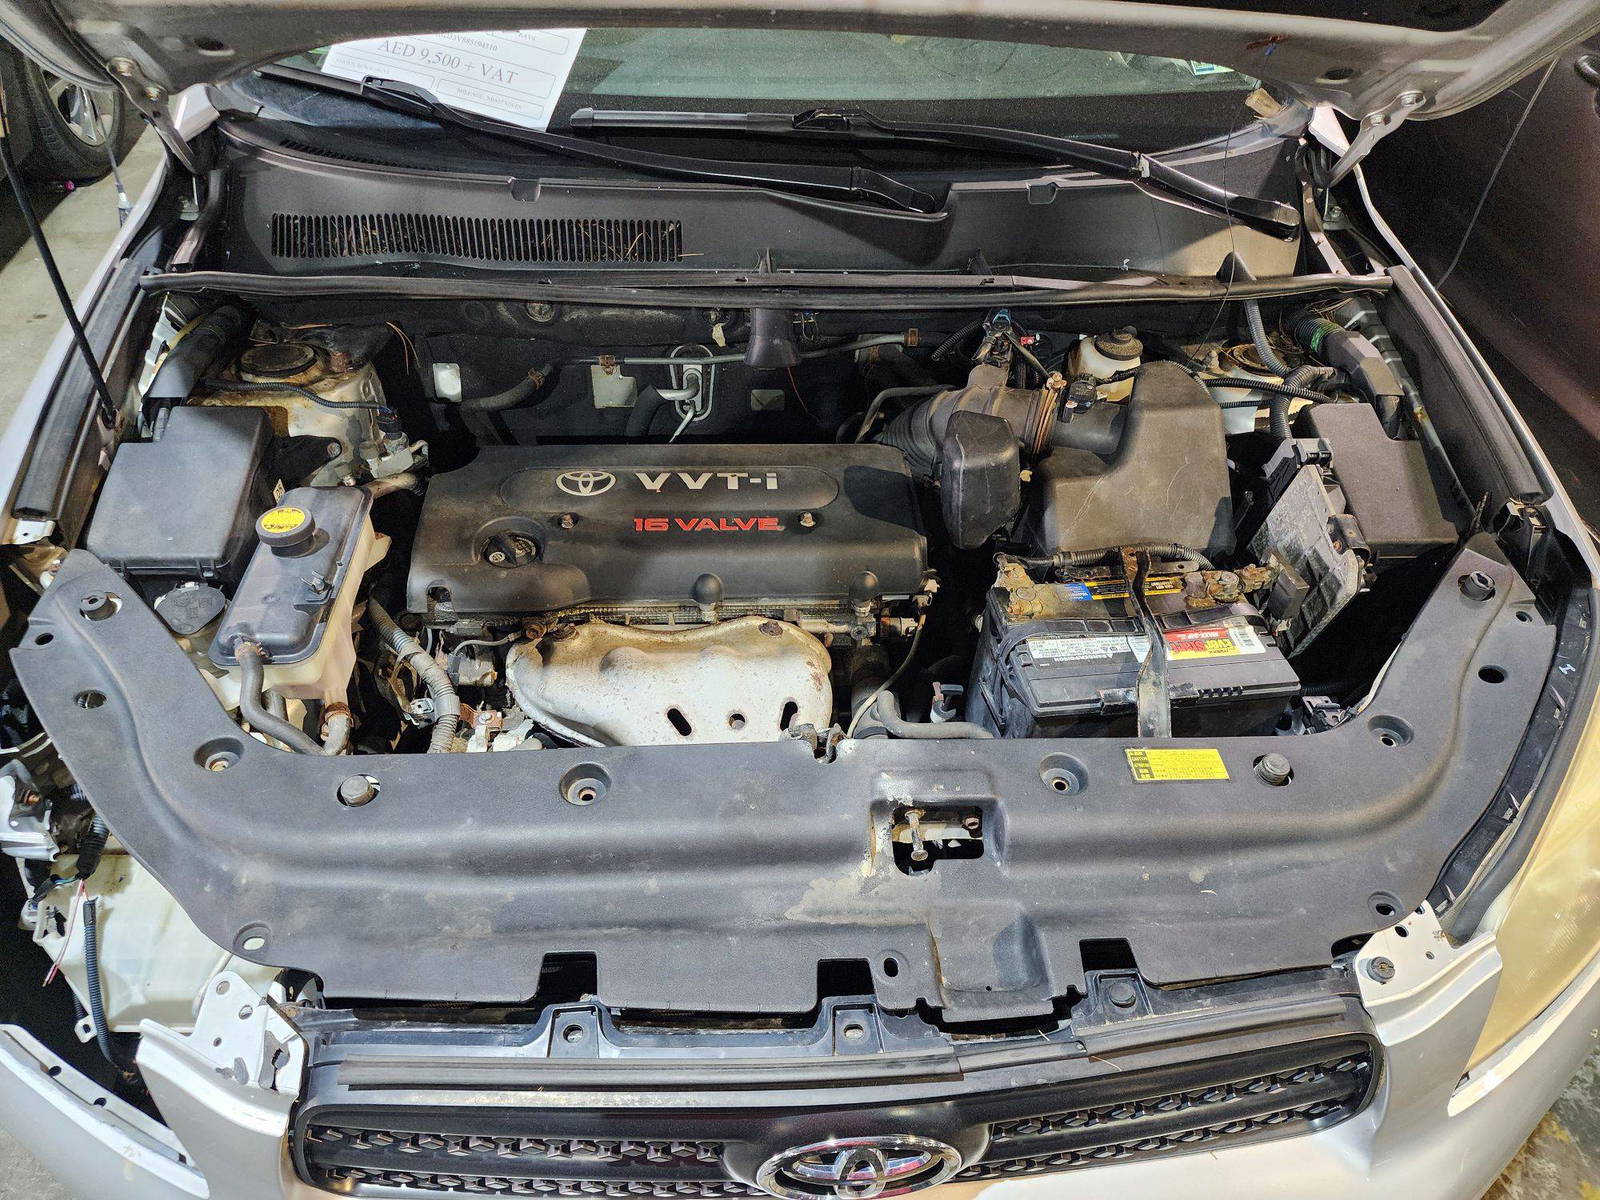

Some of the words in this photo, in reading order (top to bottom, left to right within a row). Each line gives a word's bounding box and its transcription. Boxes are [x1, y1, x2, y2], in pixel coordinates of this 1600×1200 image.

[377, 39, 417, 58] AED
[420, 48, 461, 70] 9,500
[464, 61, 476, 72] +
[481, 62, 519, 85] VAT
[634, 472, 779, 491] VVT-i
[633, 517, 669, 532] 16
[674, 517, 780, 532] VALVE
